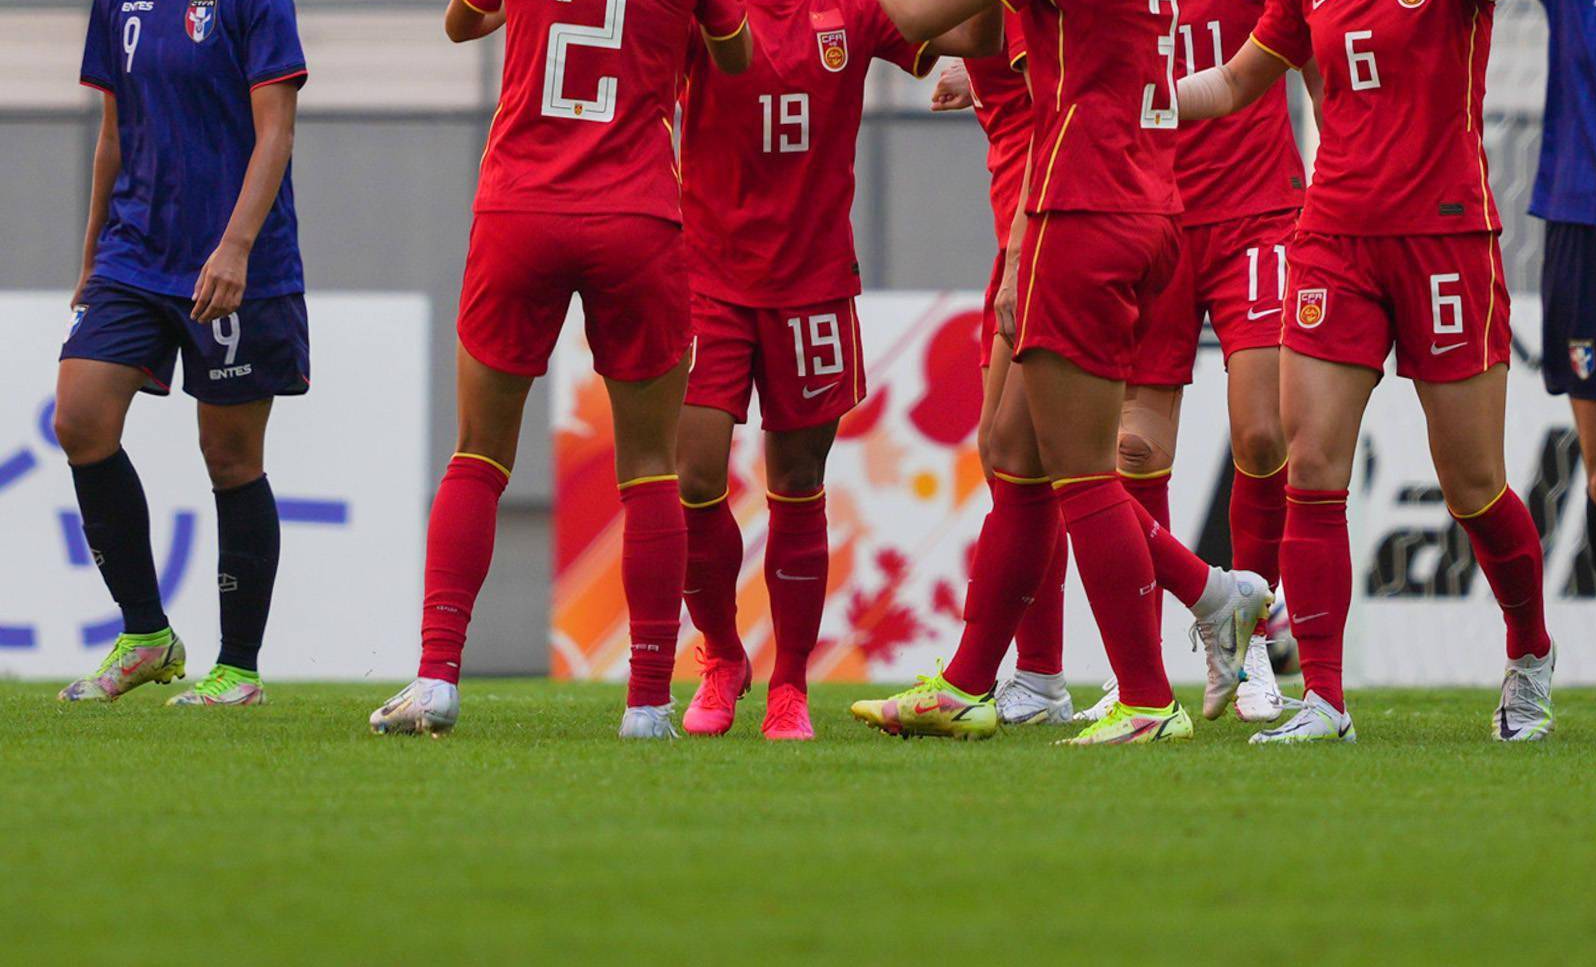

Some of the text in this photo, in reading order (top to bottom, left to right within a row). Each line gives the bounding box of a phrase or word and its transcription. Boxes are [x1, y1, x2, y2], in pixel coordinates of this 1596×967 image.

[123, 16, 141, 73] 9
[1178, 17, 1223, 78] 11
[1345, 30, 1381, 91] 6
[758, 93, 809, 152] 19
[1246, 244, 1286, 301] 11
[1430, 273, 1463, 333] 6
[211, 312, 241, 365] 9
[787, 313, 844, 377] 19
[209, 364, 252, 380] ENTES
